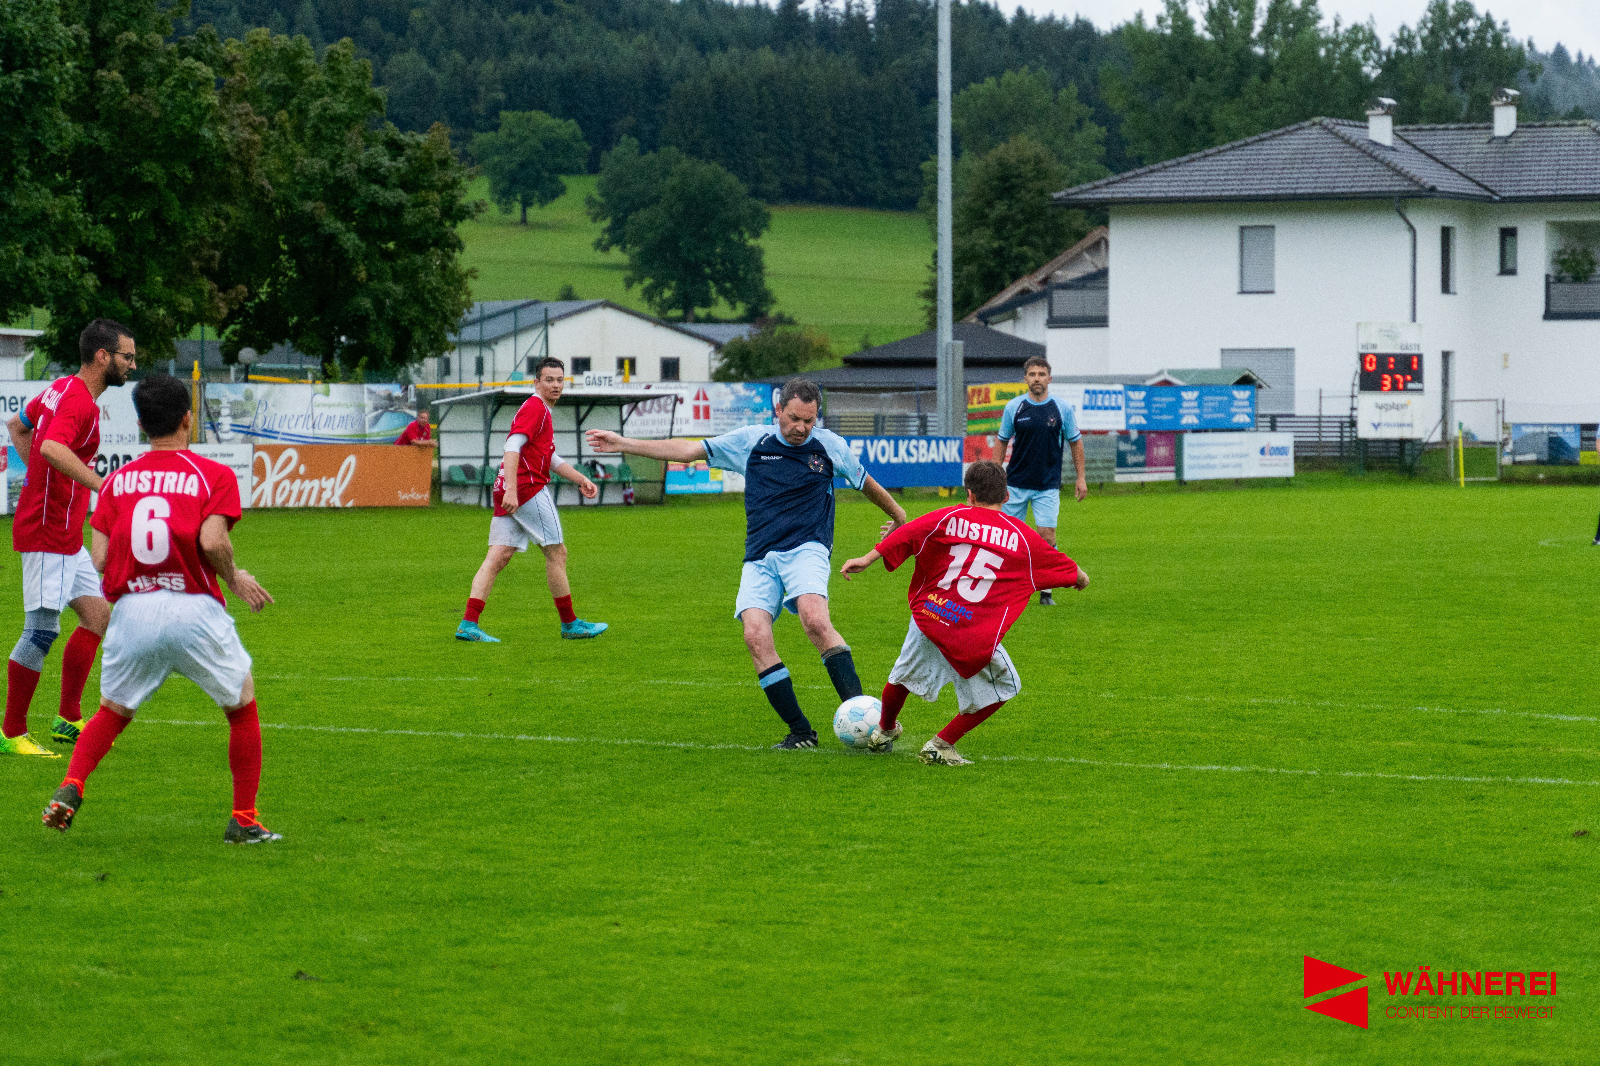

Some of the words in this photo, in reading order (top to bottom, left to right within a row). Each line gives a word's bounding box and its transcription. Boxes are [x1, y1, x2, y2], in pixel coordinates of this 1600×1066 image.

[1364, 354, 1377, 372] 0
[1411, 356, 1418, 370] 1
[865, 438, 961, 464] VOLKSBANK
[112, 470, 199, 497] AUSTRIA
[130, 496, 170, 565] 6
[944, 516, 1019, 552] AUSTRIA
[936, 543, 1005, 603] 15
